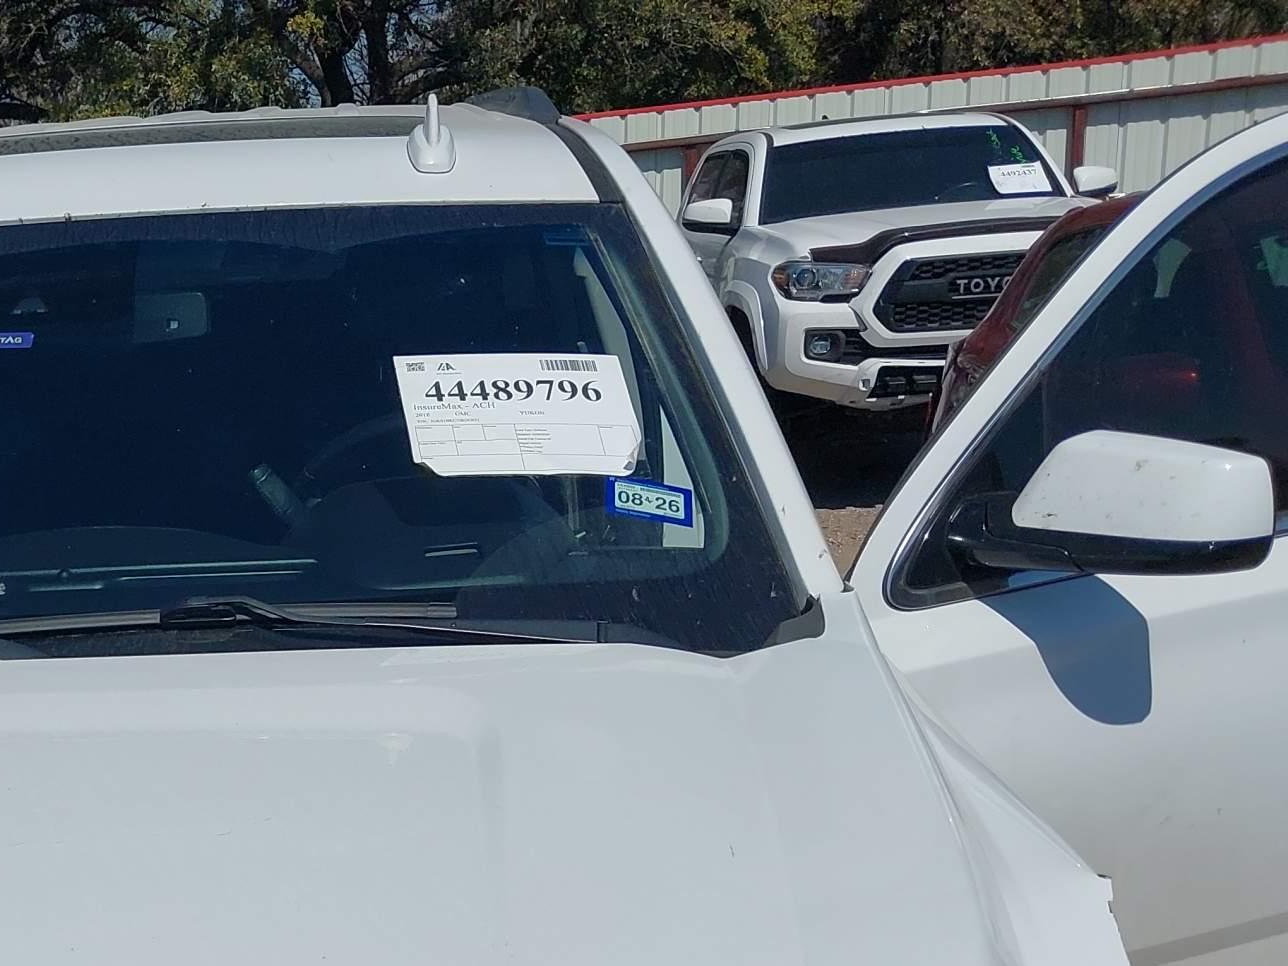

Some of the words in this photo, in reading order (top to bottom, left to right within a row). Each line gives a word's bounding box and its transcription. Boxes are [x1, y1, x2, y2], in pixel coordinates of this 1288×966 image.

[424, 379, 602, 402] 44489796
[413, 402, 463, 411] InsureMax
[472, 401, 496, 409] ACH
[617, 490, 643, 506] 08
[654, 496, 680, 513] 26
